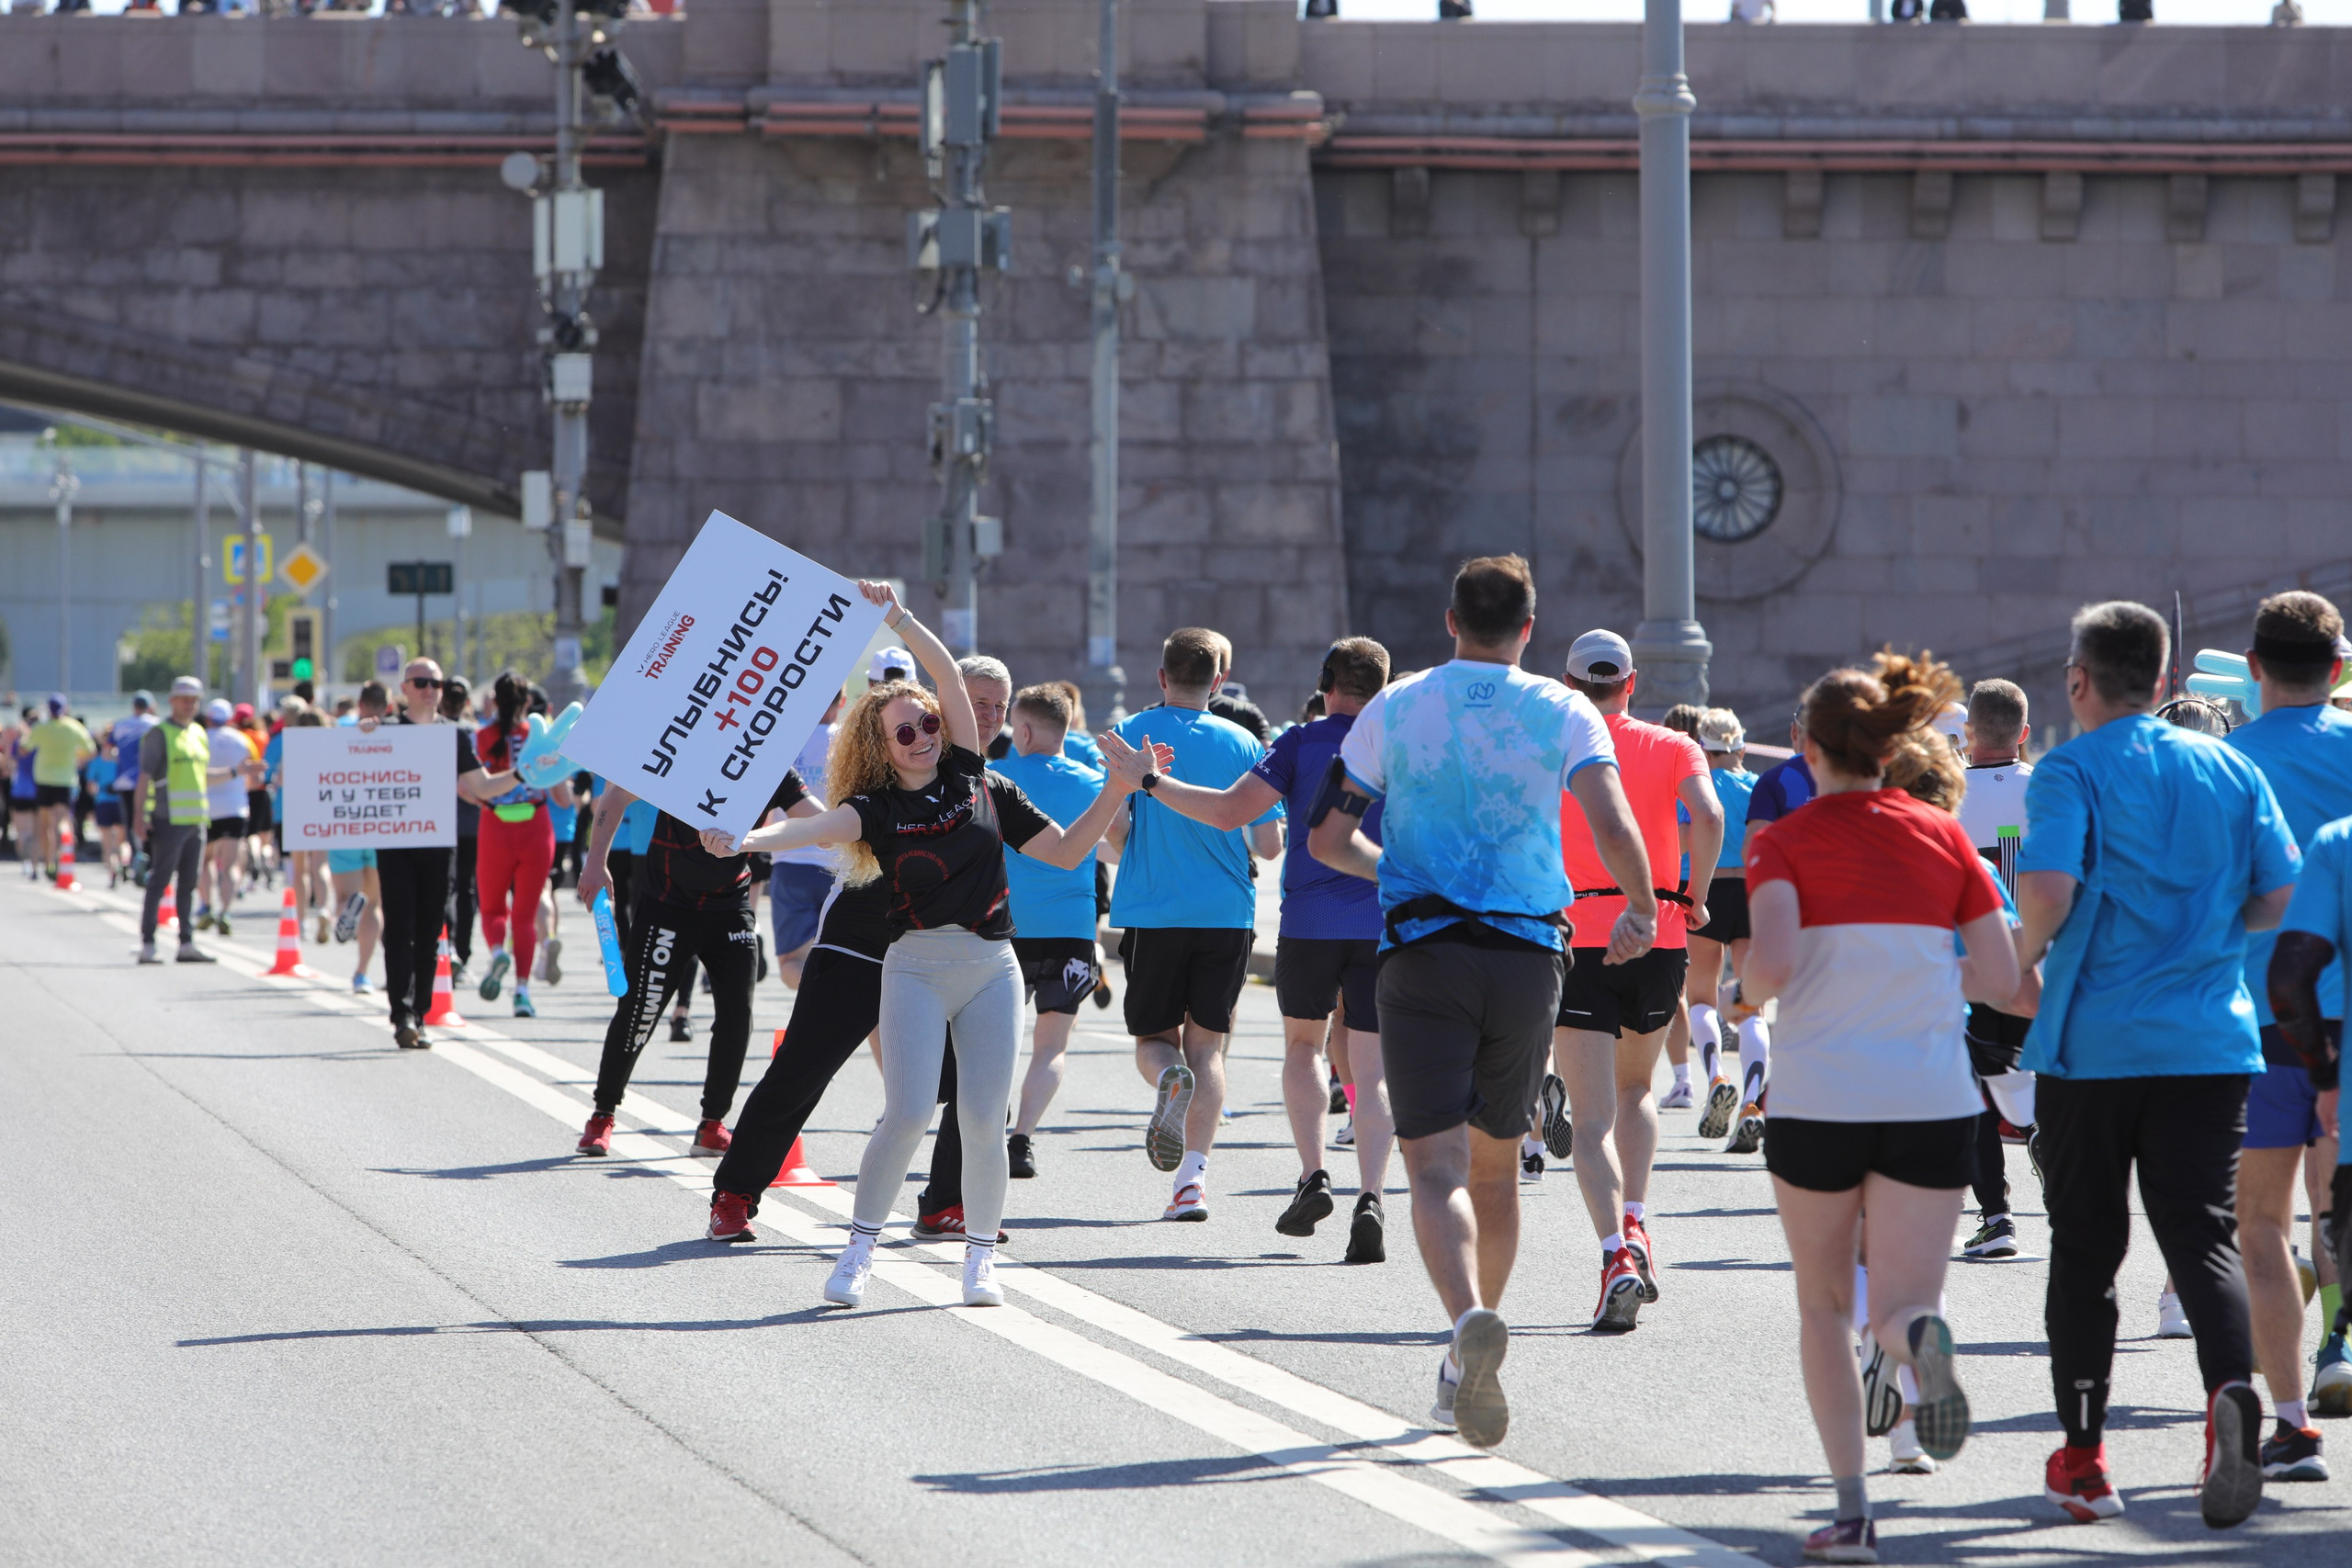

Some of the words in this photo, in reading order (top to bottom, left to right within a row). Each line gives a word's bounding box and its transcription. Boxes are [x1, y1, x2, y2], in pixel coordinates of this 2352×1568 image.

[643, 641, 660, 663] HERO
[658, 610, 681, 642] LEAGUE
[644, 615, 695, 680] TRAINING
[641, 569, 789, 778] УЛЫБНИСЬ!
[713, 646, 779, 731] +100
[696, 787, 728, 818] К
[720, 592, 852, 781] СКОРОСТИ
[347, 744, 393, 754] TRAINING
[318, 770, 422, 785] КОСНИСЬ
[319, 789, 333, 802] И
[342, 788, 356, 803] У
[365, 786, 421, 800] ТЕБЯ
[303, 820, 436, 838] СУПЕРСИЛА
[334, 805, 407, 819] БУДЕТ
[652, 927, 676, 965] NO
